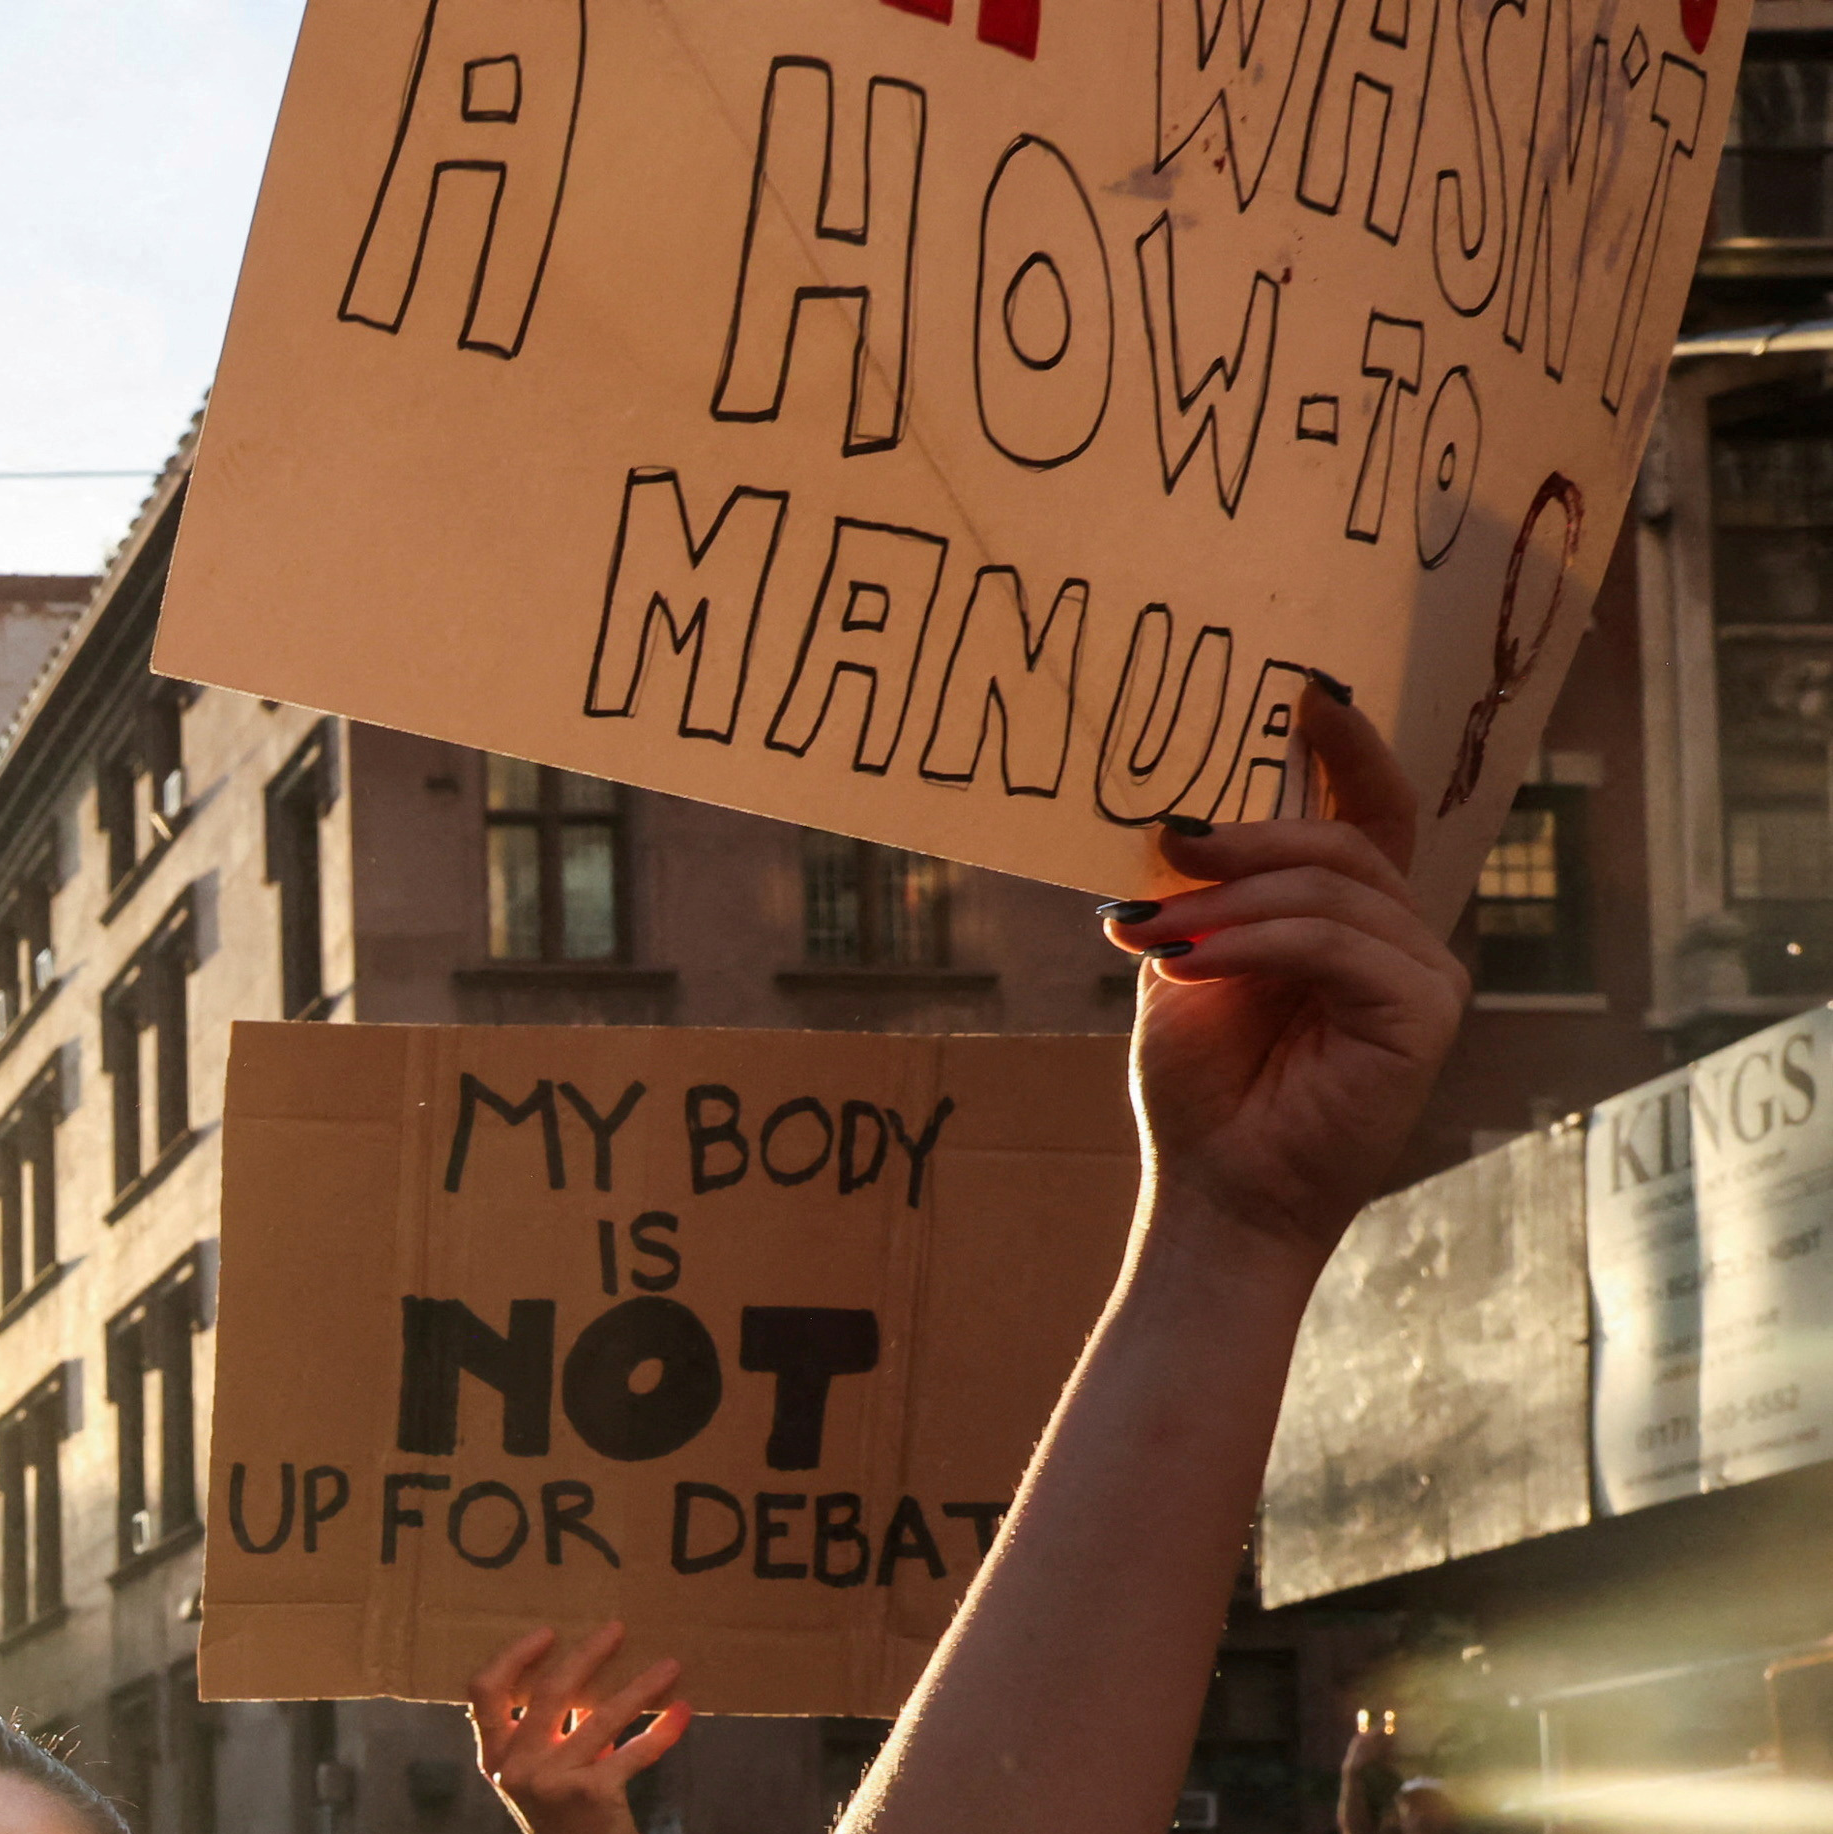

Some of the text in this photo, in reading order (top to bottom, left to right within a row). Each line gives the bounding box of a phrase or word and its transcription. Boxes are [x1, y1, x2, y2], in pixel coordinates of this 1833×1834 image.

[337, 0, 1482, 568] A HOW-TO
[1154, 0, 1707, 415] WASN'T
[443, 1073, 955, 1208] MY BODY
[1609, 1032, 1816, 1195] KINGS
[599, 1211, 681, 1295] IS
[397, 1295, 879, 1470] NOT
[228, 1463, 349, 1555] UP
[381, 1473, 621, 1569] FOR
